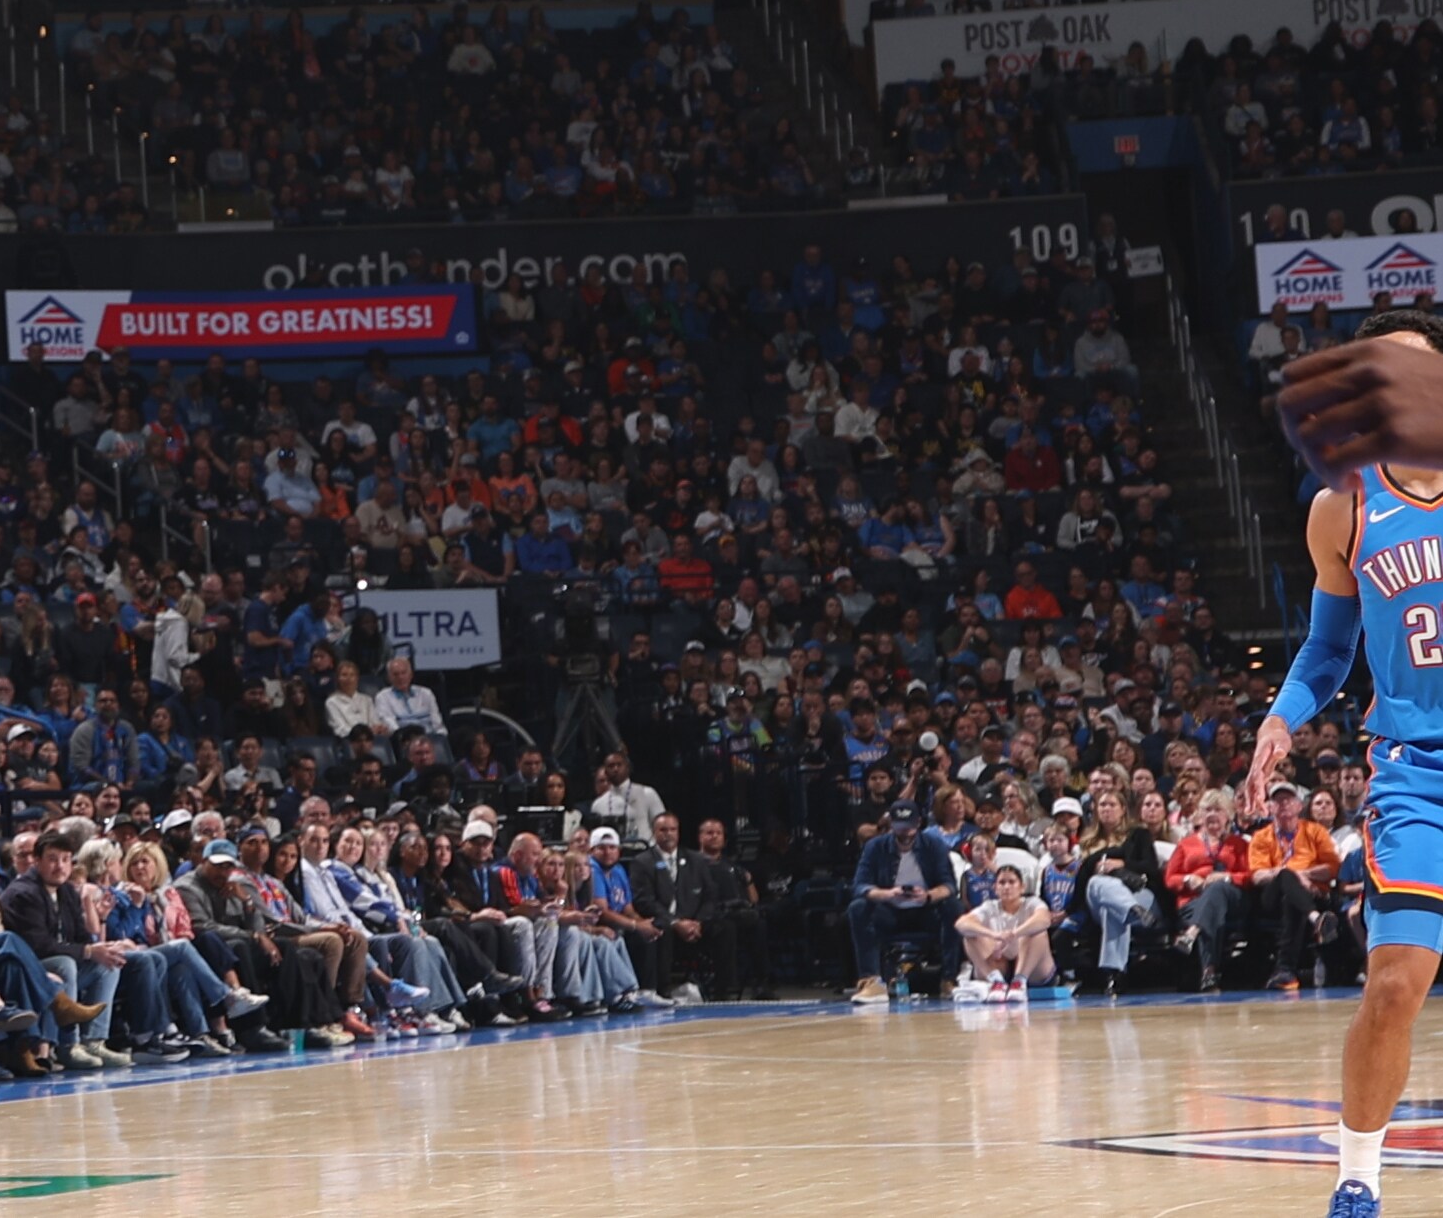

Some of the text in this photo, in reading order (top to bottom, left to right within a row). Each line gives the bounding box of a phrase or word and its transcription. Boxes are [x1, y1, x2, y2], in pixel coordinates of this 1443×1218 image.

[964, 13, 1112, 52] POST OAK
[999, 49, 1089, 73] OYTA
[1009, 223, 1080, 263] 109
[1275, 269, 1435, 295] HOME HOME
[1369, 286, 1438, 300] CATIONS
[119, 304, 433, 337] BUILT FOR GREATNESS!
[21, 326, 83, 345] HOME
[21, 347, 84, 357] CATIONS
[1361, 536, 1443, 600] THUN
[1403, 603, 1443, 668] 2
